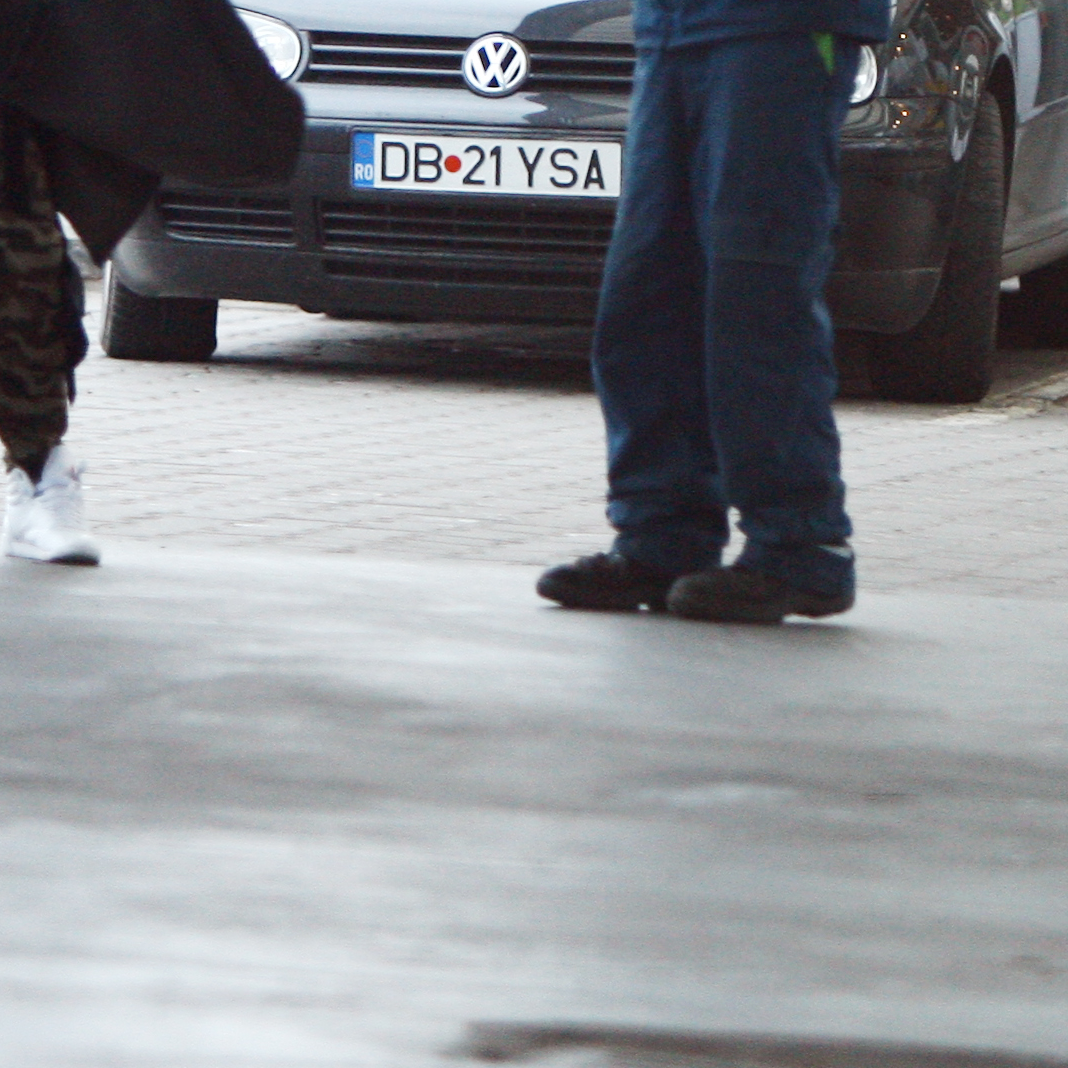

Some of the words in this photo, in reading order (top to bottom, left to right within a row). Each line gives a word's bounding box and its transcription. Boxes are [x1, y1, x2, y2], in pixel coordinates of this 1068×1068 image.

[463, 32, 529, 97] VW
[354, 163, 373, 181] RO
[381, 141, 443, 183] DB
[462, 145, 502, 186] 21
[517, 147, 605, 190] YSA
